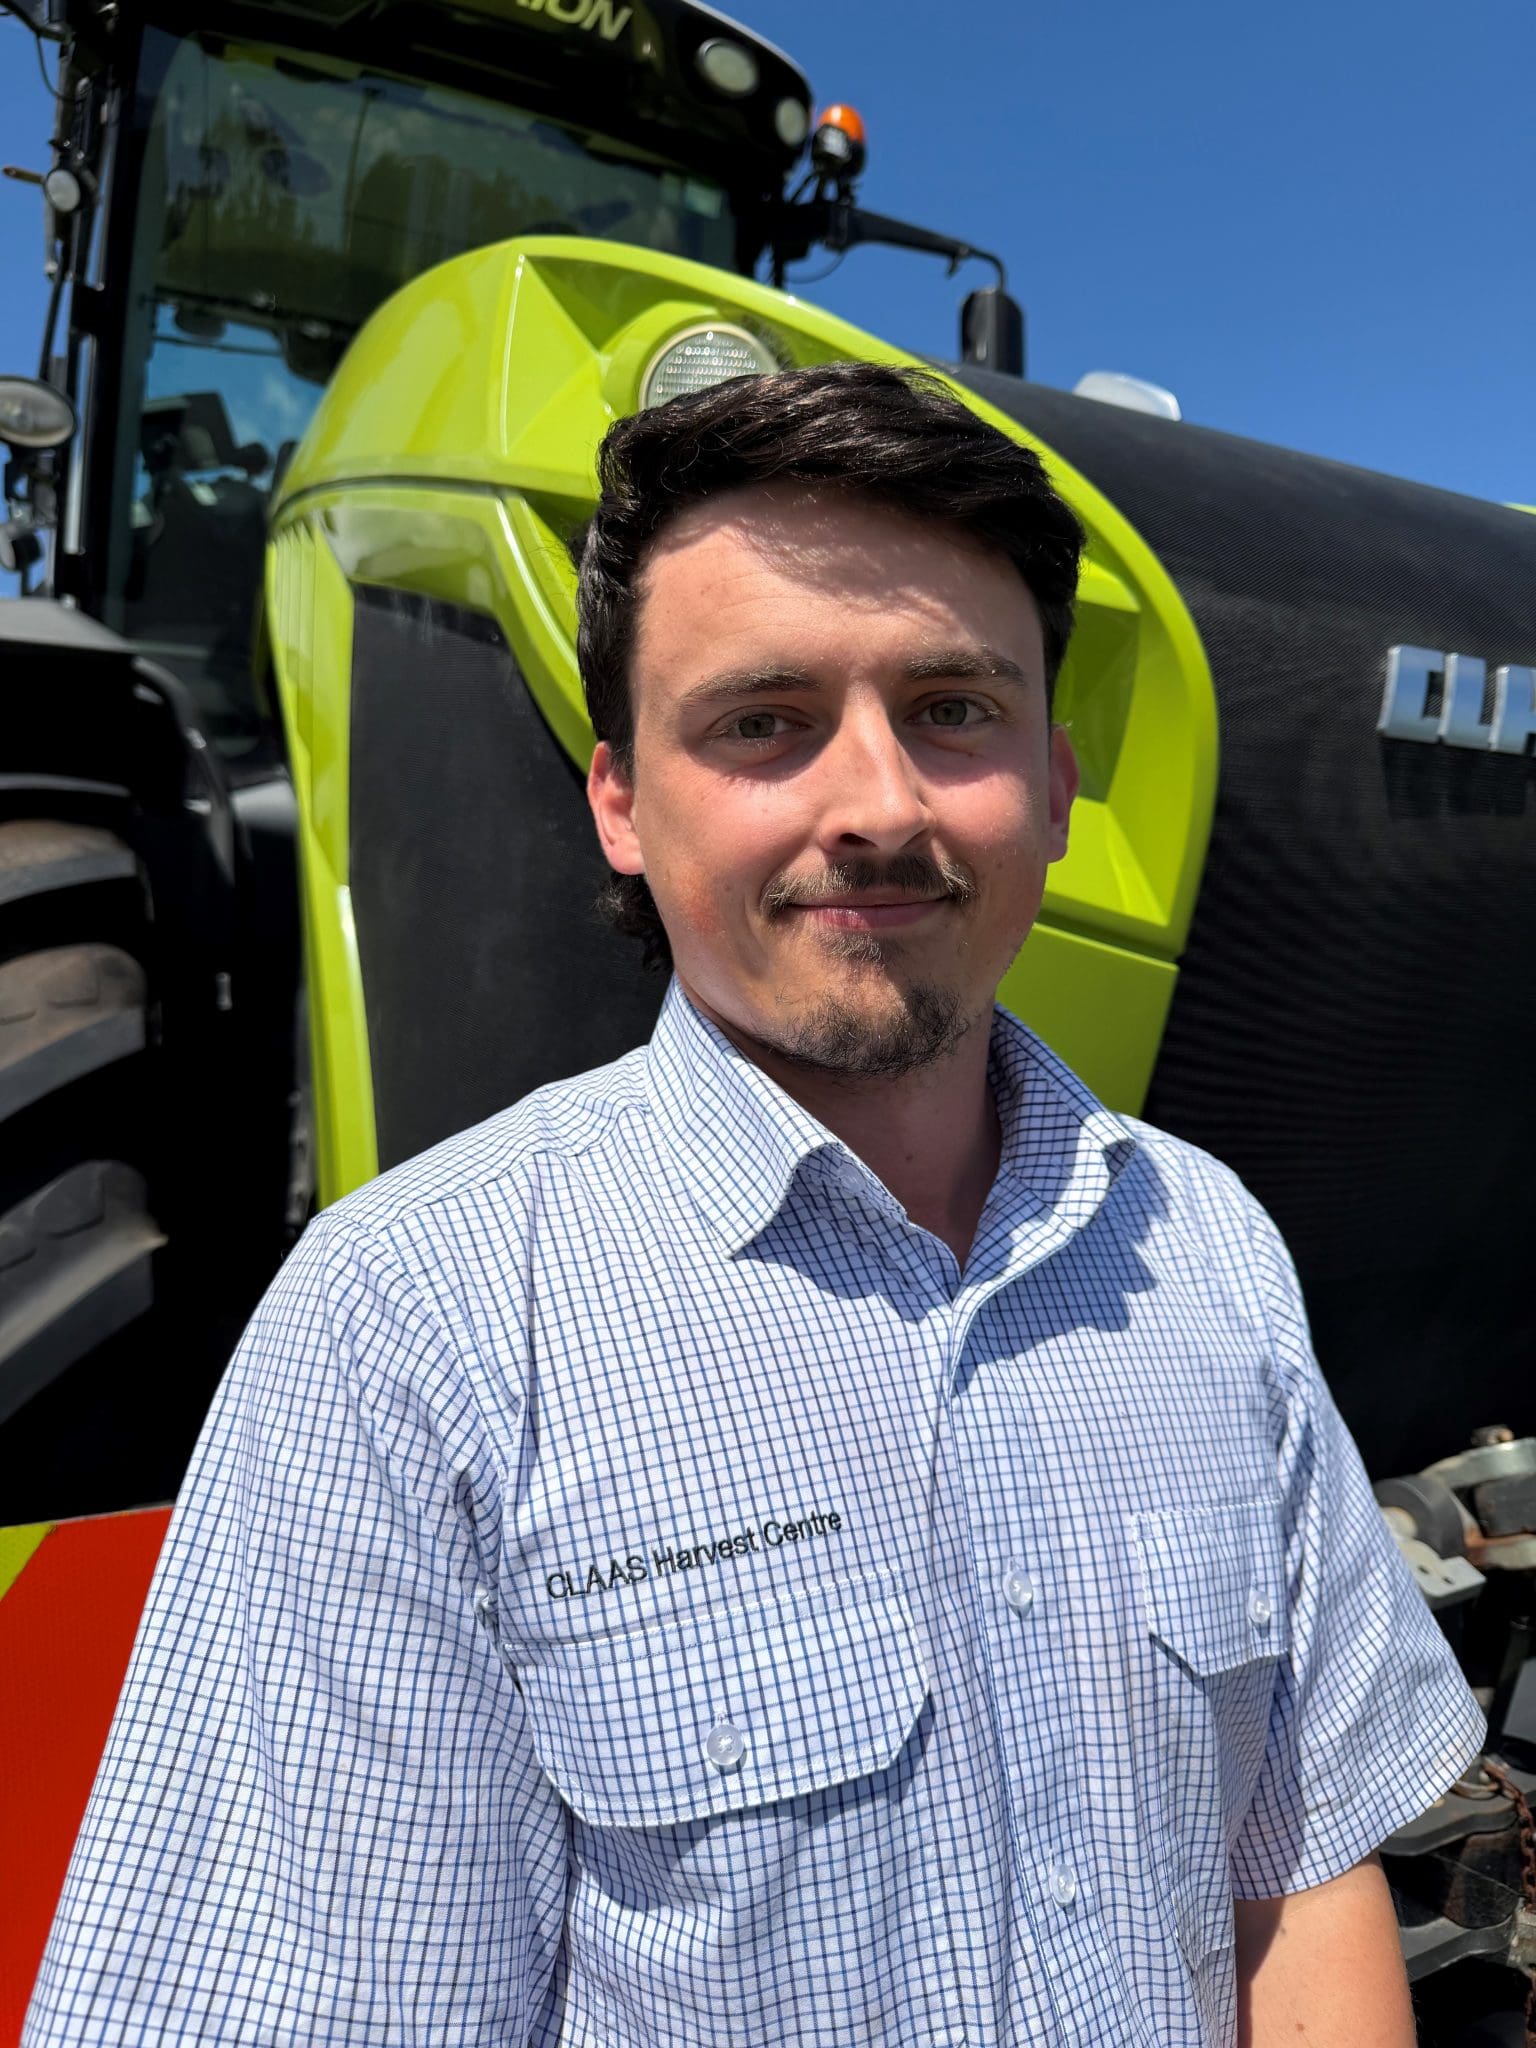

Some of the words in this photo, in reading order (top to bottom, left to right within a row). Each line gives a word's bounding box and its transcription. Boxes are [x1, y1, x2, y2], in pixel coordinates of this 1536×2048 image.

[545, 1555, 648, 1600] CLAAS
[652, 1527, 759, 1577] Harvest
[762, 1510, 842, 1547] Centre
